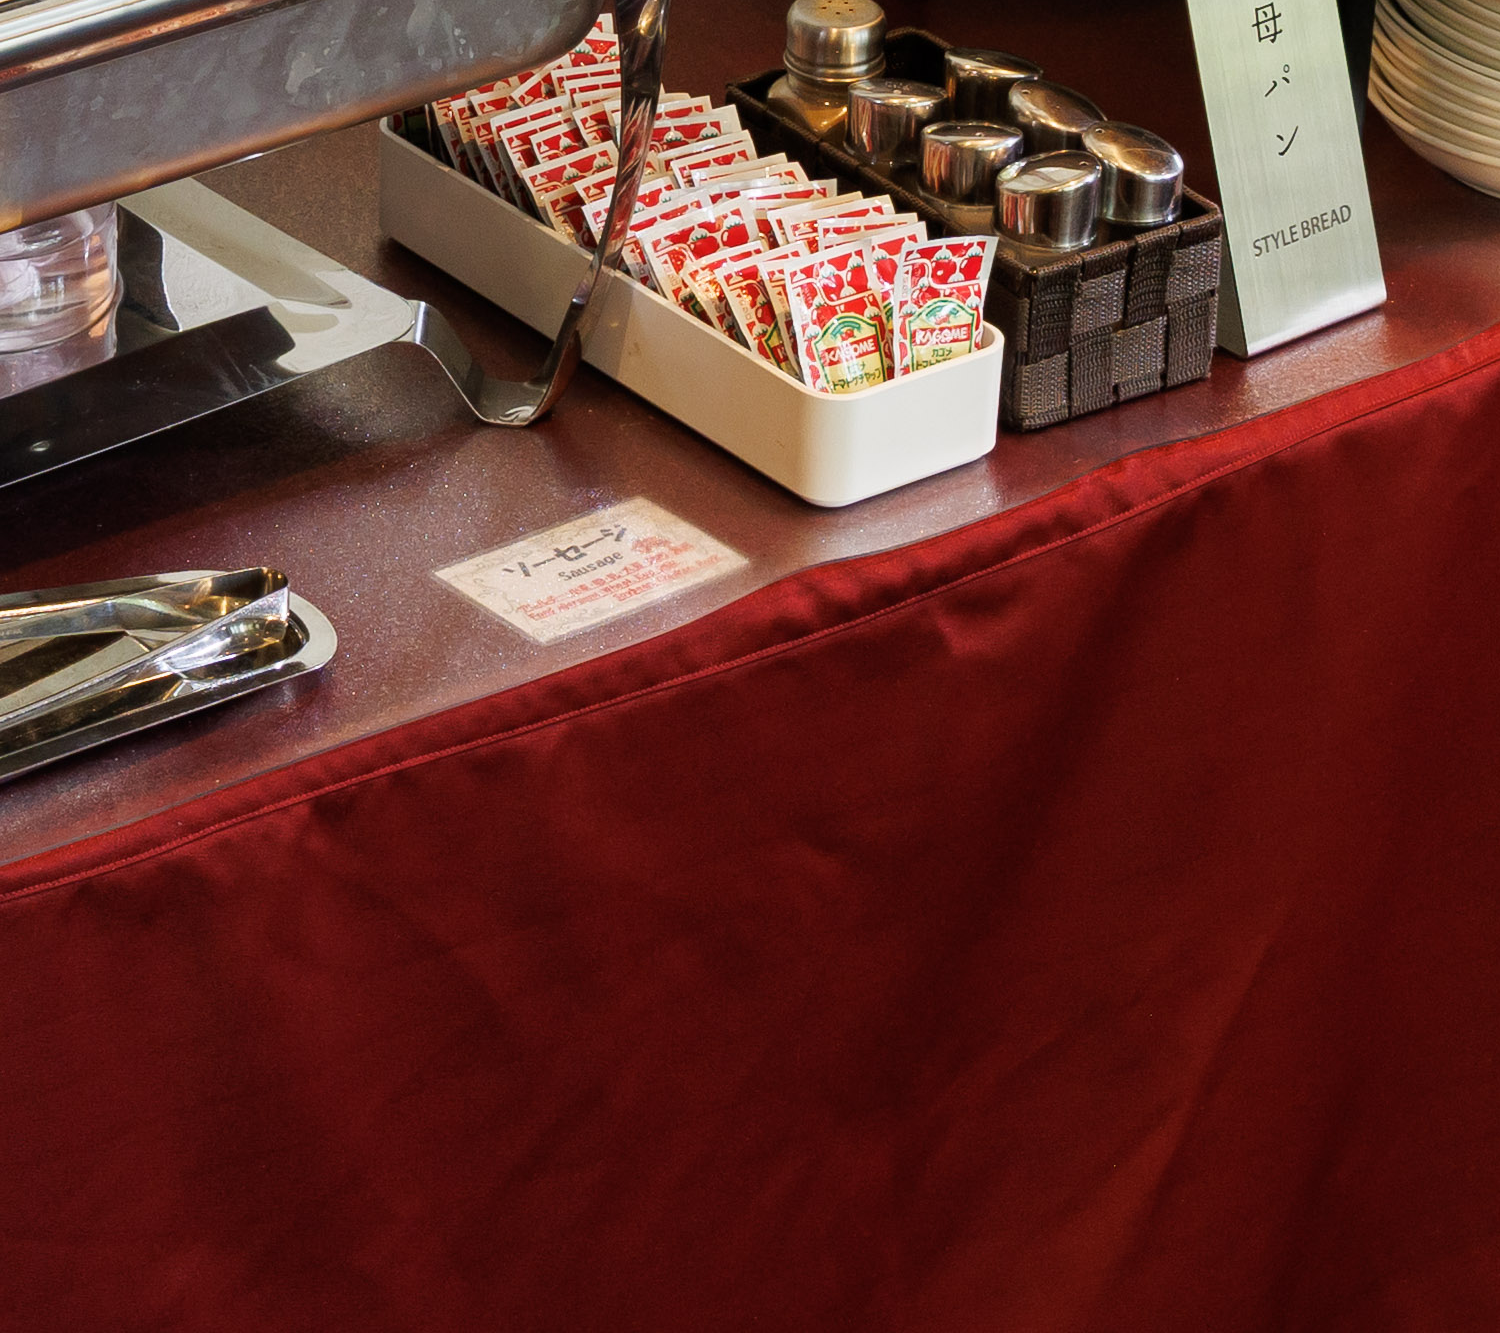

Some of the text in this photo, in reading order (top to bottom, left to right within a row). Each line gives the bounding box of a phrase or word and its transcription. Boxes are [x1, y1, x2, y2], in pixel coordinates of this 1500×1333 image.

[1252, 204, 1352, 258] STYLE BREAD
[915, 326, 968, 346] KAGOME
[502, 524, 627, 577] ソーセージ
[557, 550, 624, 581] Sausage
